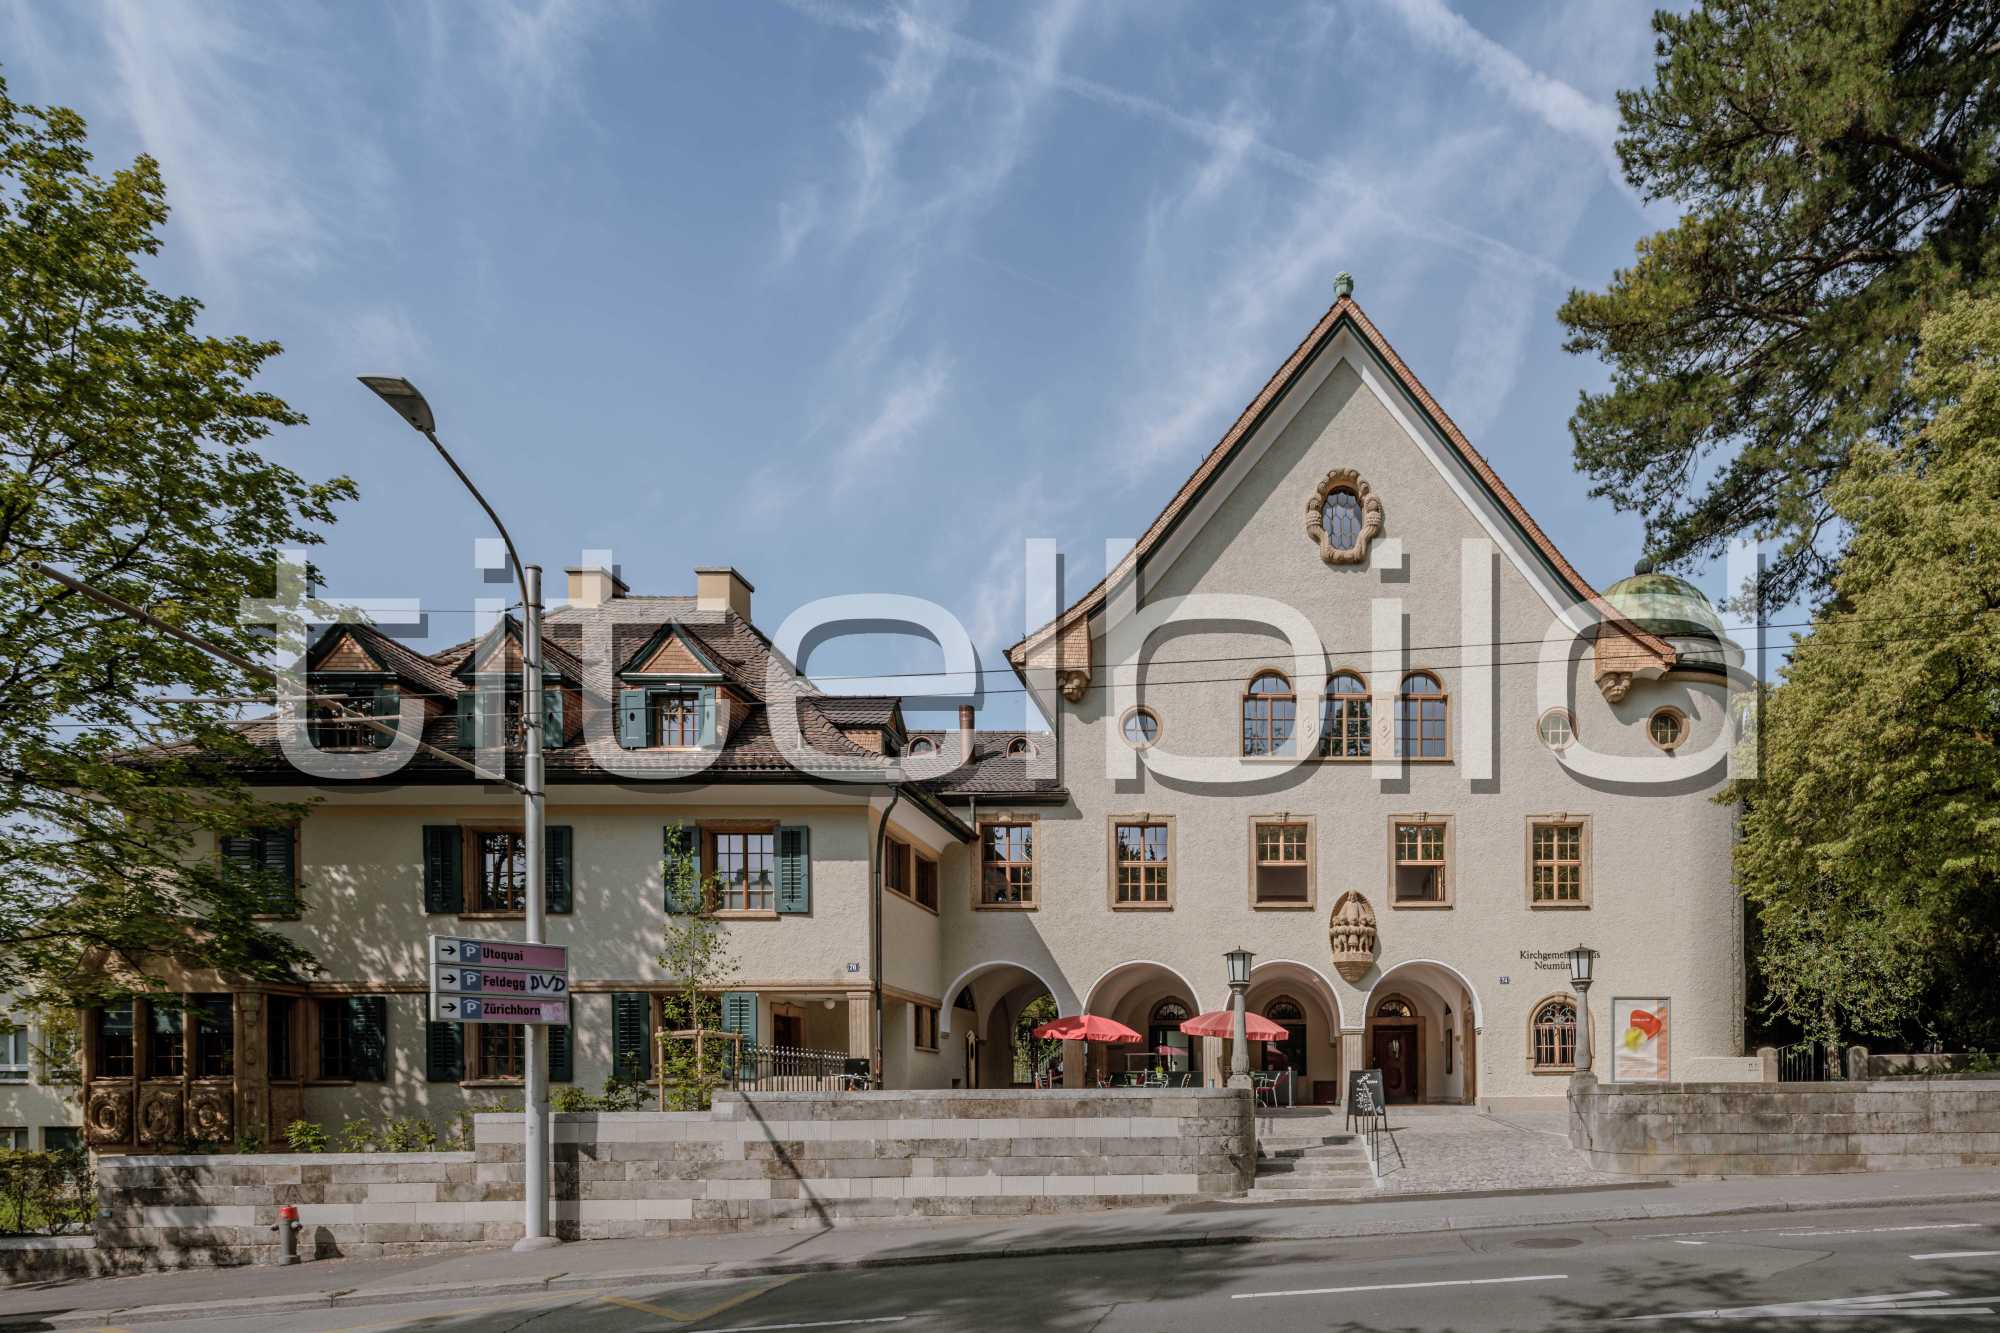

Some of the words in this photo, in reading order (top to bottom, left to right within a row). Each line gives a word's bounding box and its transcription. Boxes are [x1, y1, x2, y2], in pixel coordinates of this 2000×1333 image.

[466, 946, 476, 958] P
[483, 947, 524, 962] Utoquai
[466, 974, 476, 986] P
[483, 975, 526, 991] Feldegg
[530, 975, 566, 992] DVD
[466, 1002, 477, 1014] P
[484, 1003, 541, 1016] Zürichhorn
